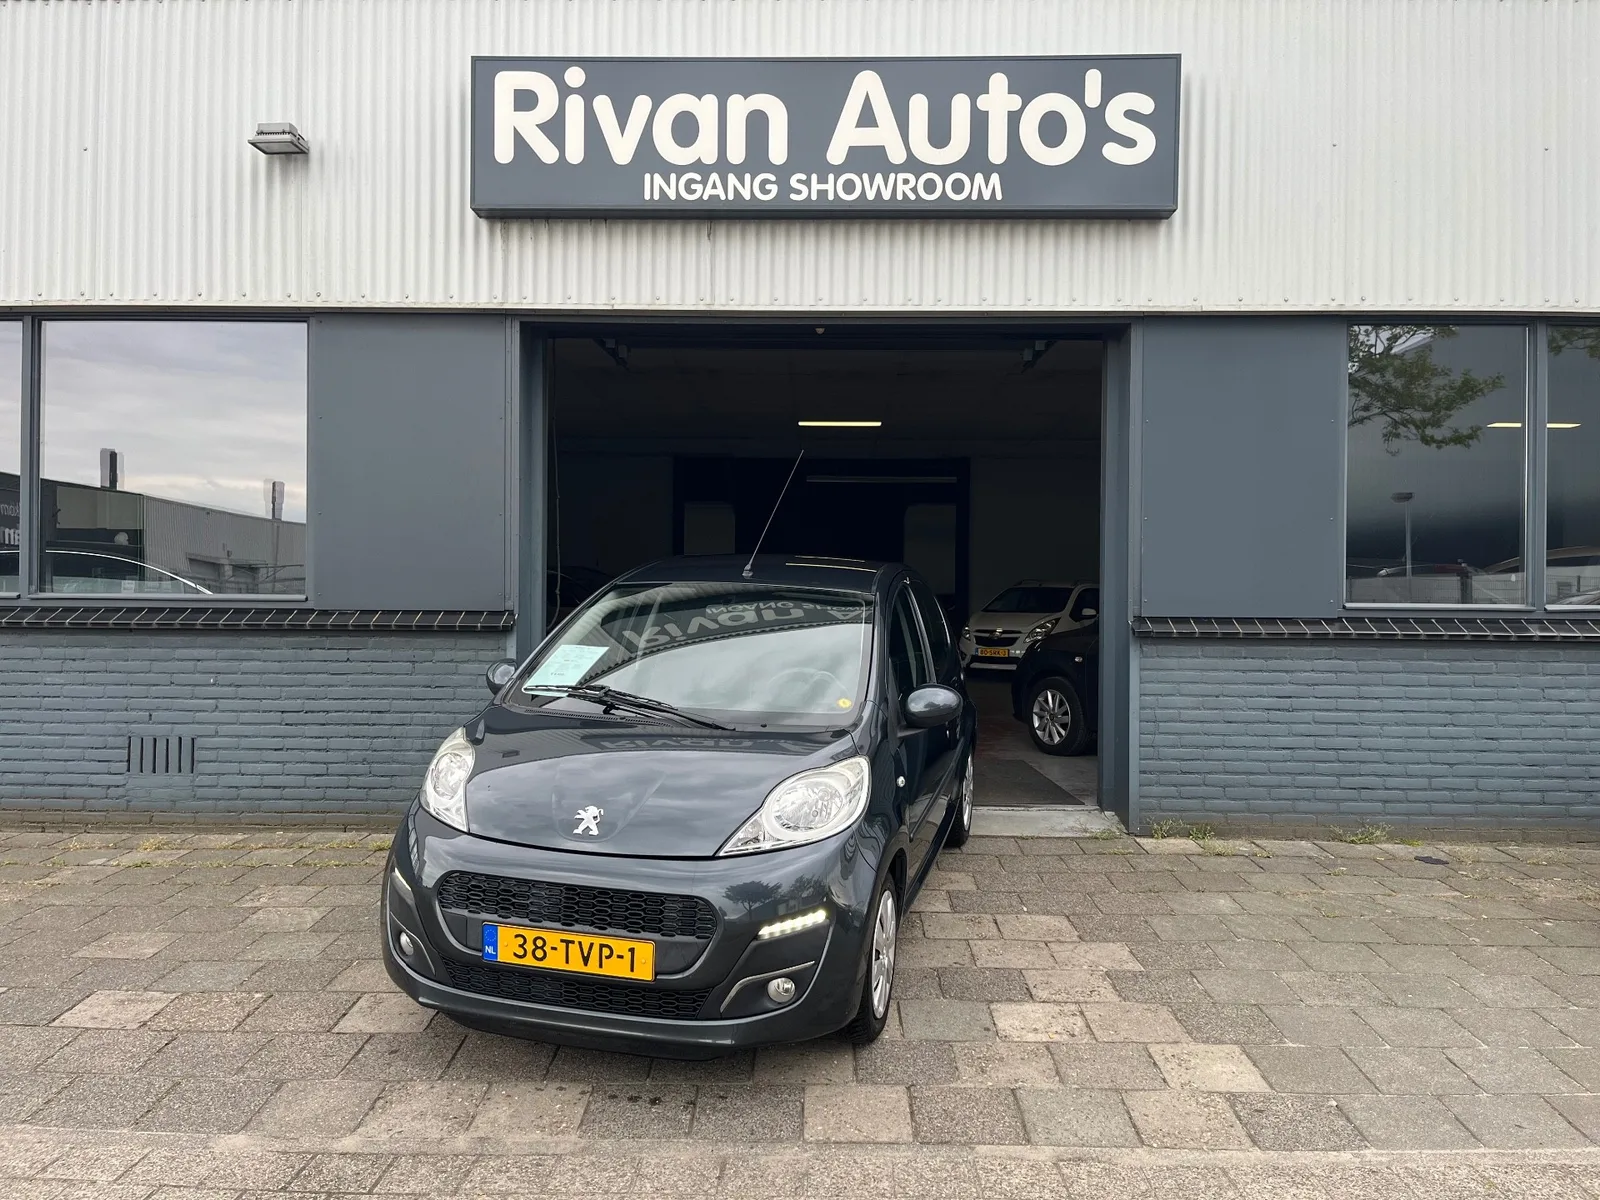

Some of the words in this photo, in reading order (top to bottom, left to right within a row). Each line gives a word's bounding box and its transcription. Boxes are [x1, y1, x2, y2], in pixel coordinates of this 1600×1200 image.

[493, 65, 789, 166] Rivan
[826, 68, 1157, 166] Auto's
[643, 171, 779, 202] INGANG
[789, 171, 1003, 202] SHOWROOM
[485, 945, 497, 956] NL
[513, 933, 636, 973] 38-TVP-1
